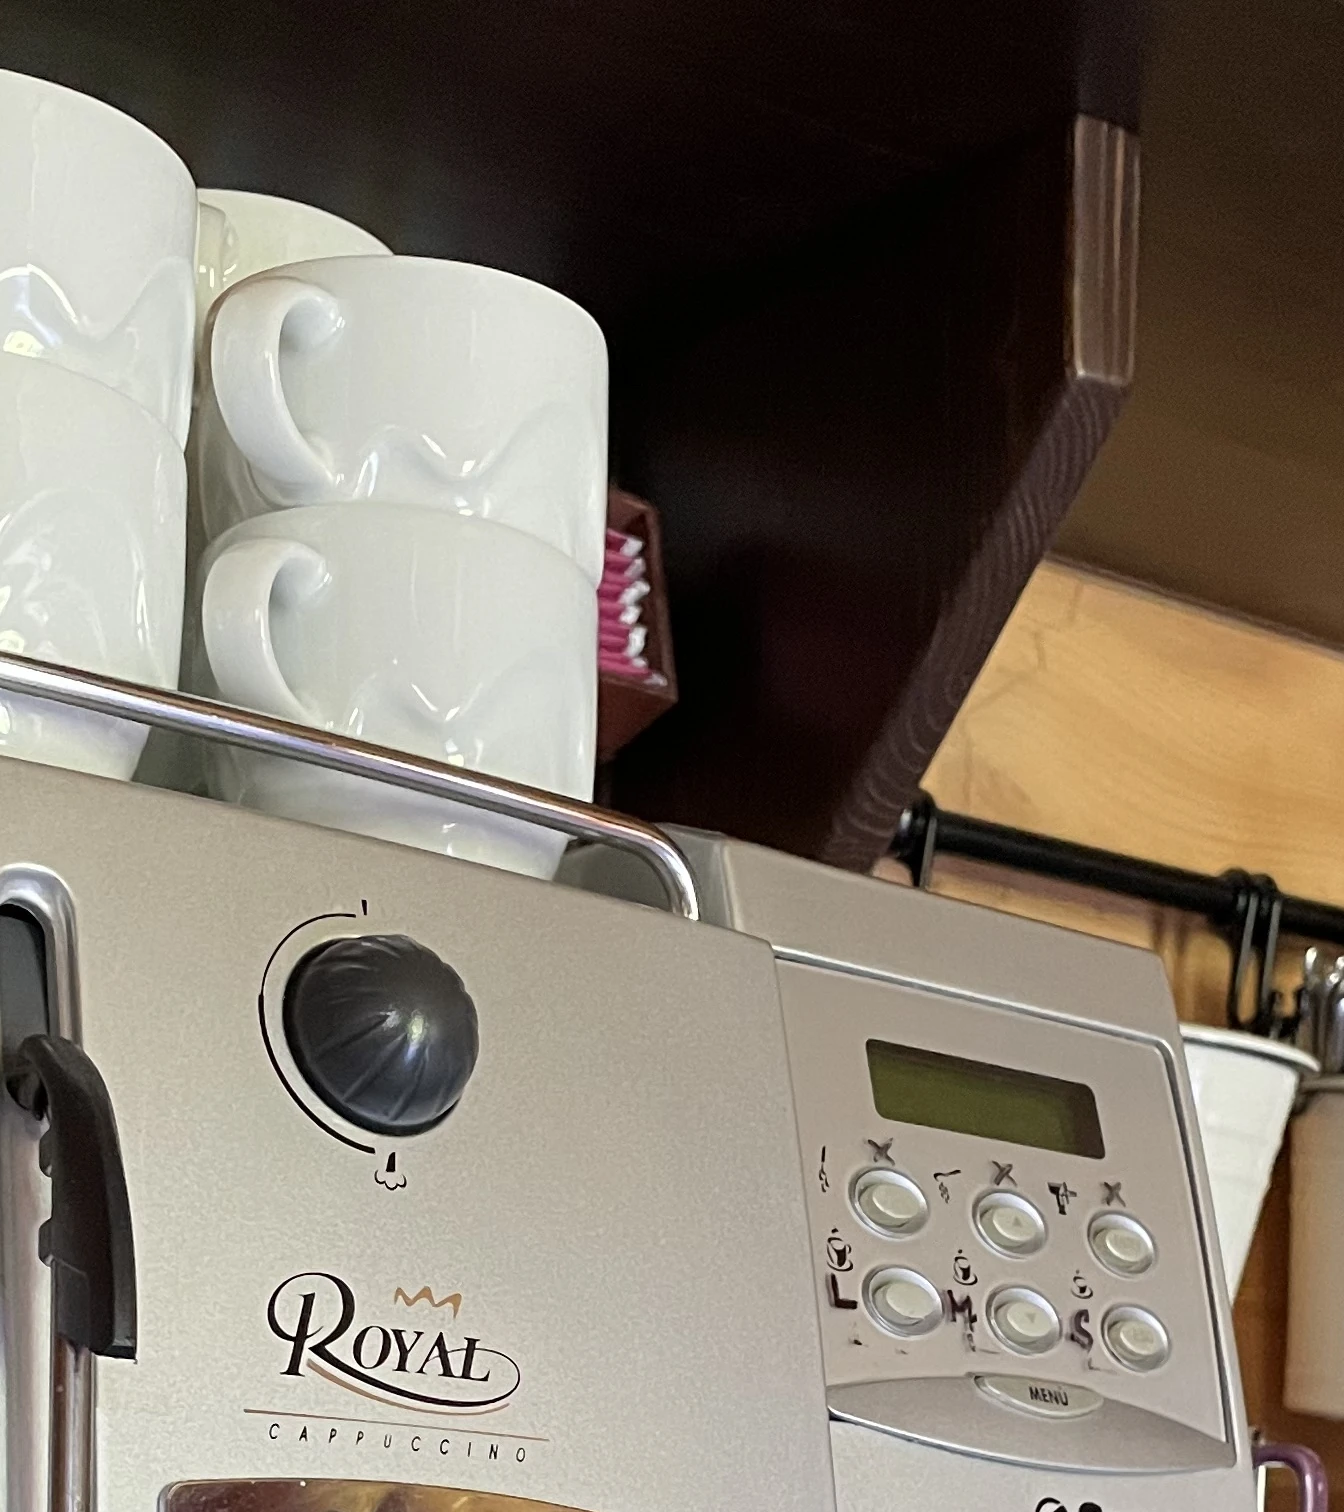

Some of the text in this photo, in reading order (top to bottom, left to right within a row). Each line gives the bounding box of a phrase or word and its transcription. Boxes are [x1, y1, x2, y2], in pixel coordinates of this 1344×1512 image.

[825, 1273, 858, 1310] L
[1068, 1309, 1094, 1351] S
[268, 1424, 527, 1463] CAPPUCCINO
